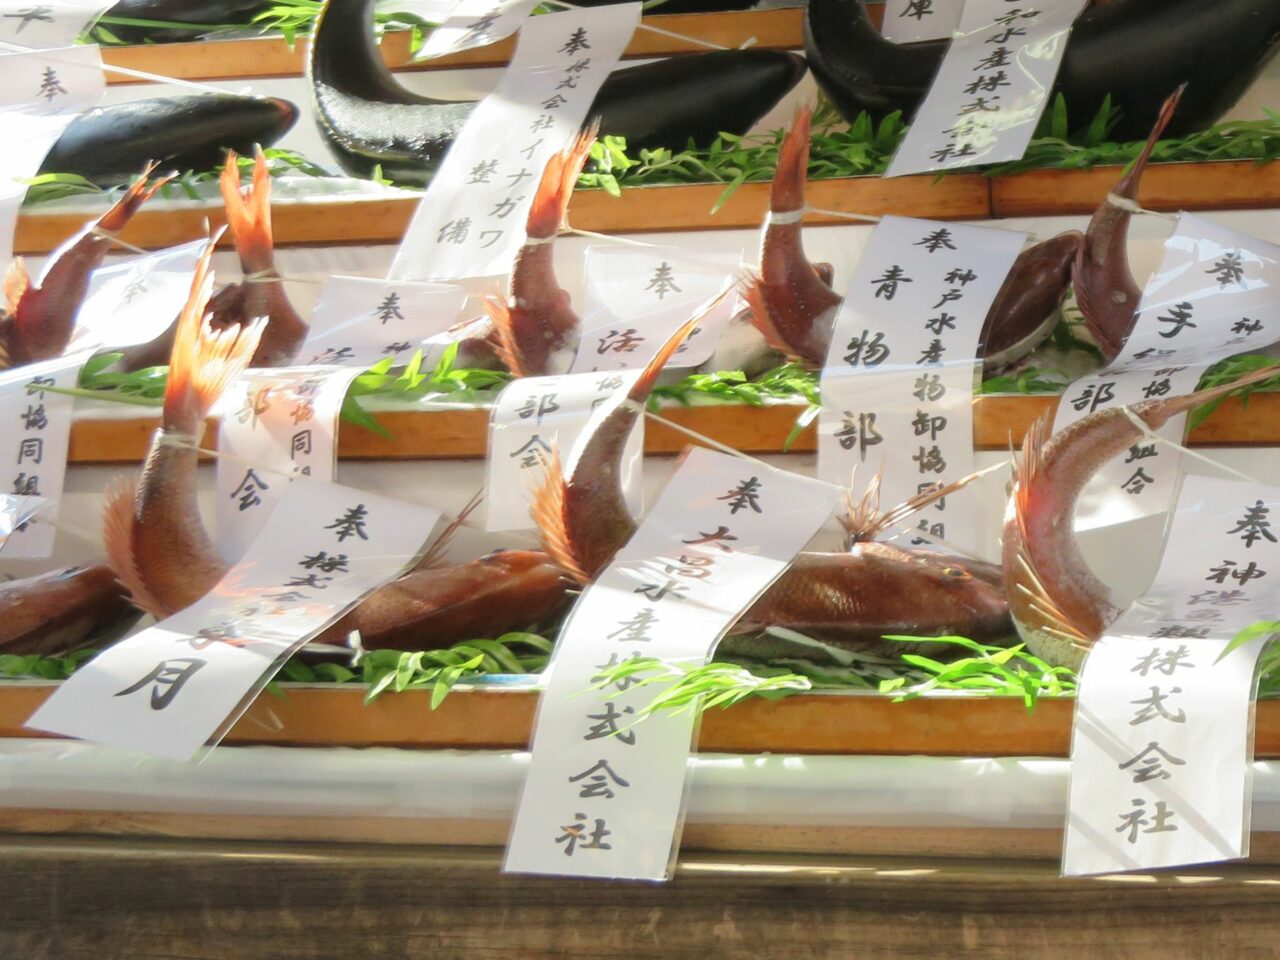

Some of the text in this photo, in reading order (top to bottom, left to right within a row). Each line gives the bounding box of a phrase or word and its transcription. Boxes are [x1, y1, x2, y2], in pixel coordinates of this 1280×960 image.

[37, 65, 68, 102] 奉
[913, 227, 957, 253] 奉
[645, 262, 682, 300] 奉
[1205, 249, 1248, 290] 奉
[371, 292, 405, 325] 奉
[833, 265, 914, 463] 青物部
